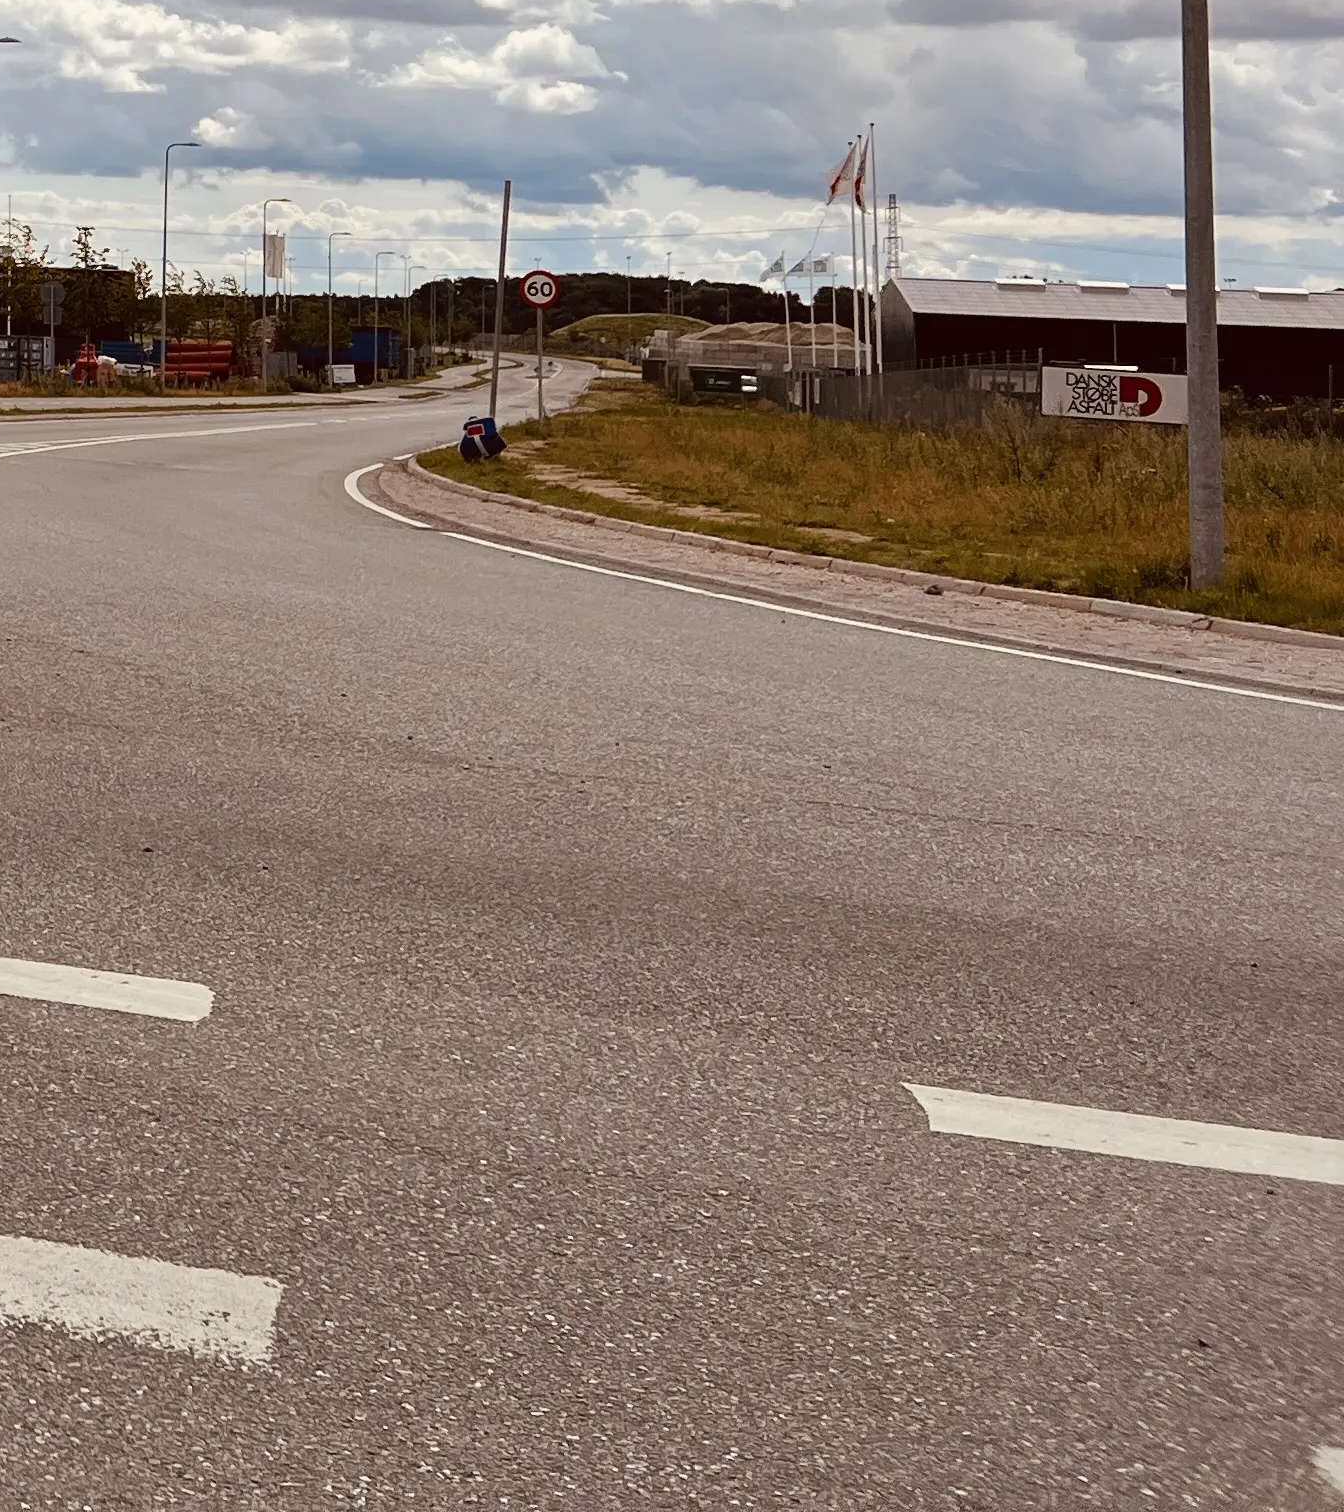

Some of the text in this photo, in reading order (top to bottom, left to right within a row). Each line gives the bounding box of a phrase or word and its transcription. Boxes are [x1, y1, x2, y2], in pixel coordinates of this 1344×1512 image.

[527, 281, 553, 297] 60
[1066, 372, 1117, 388] DANSK
[1072, 387, 1117, 402] STØBE
[1068, 400, 1117, 415] ASFALT
